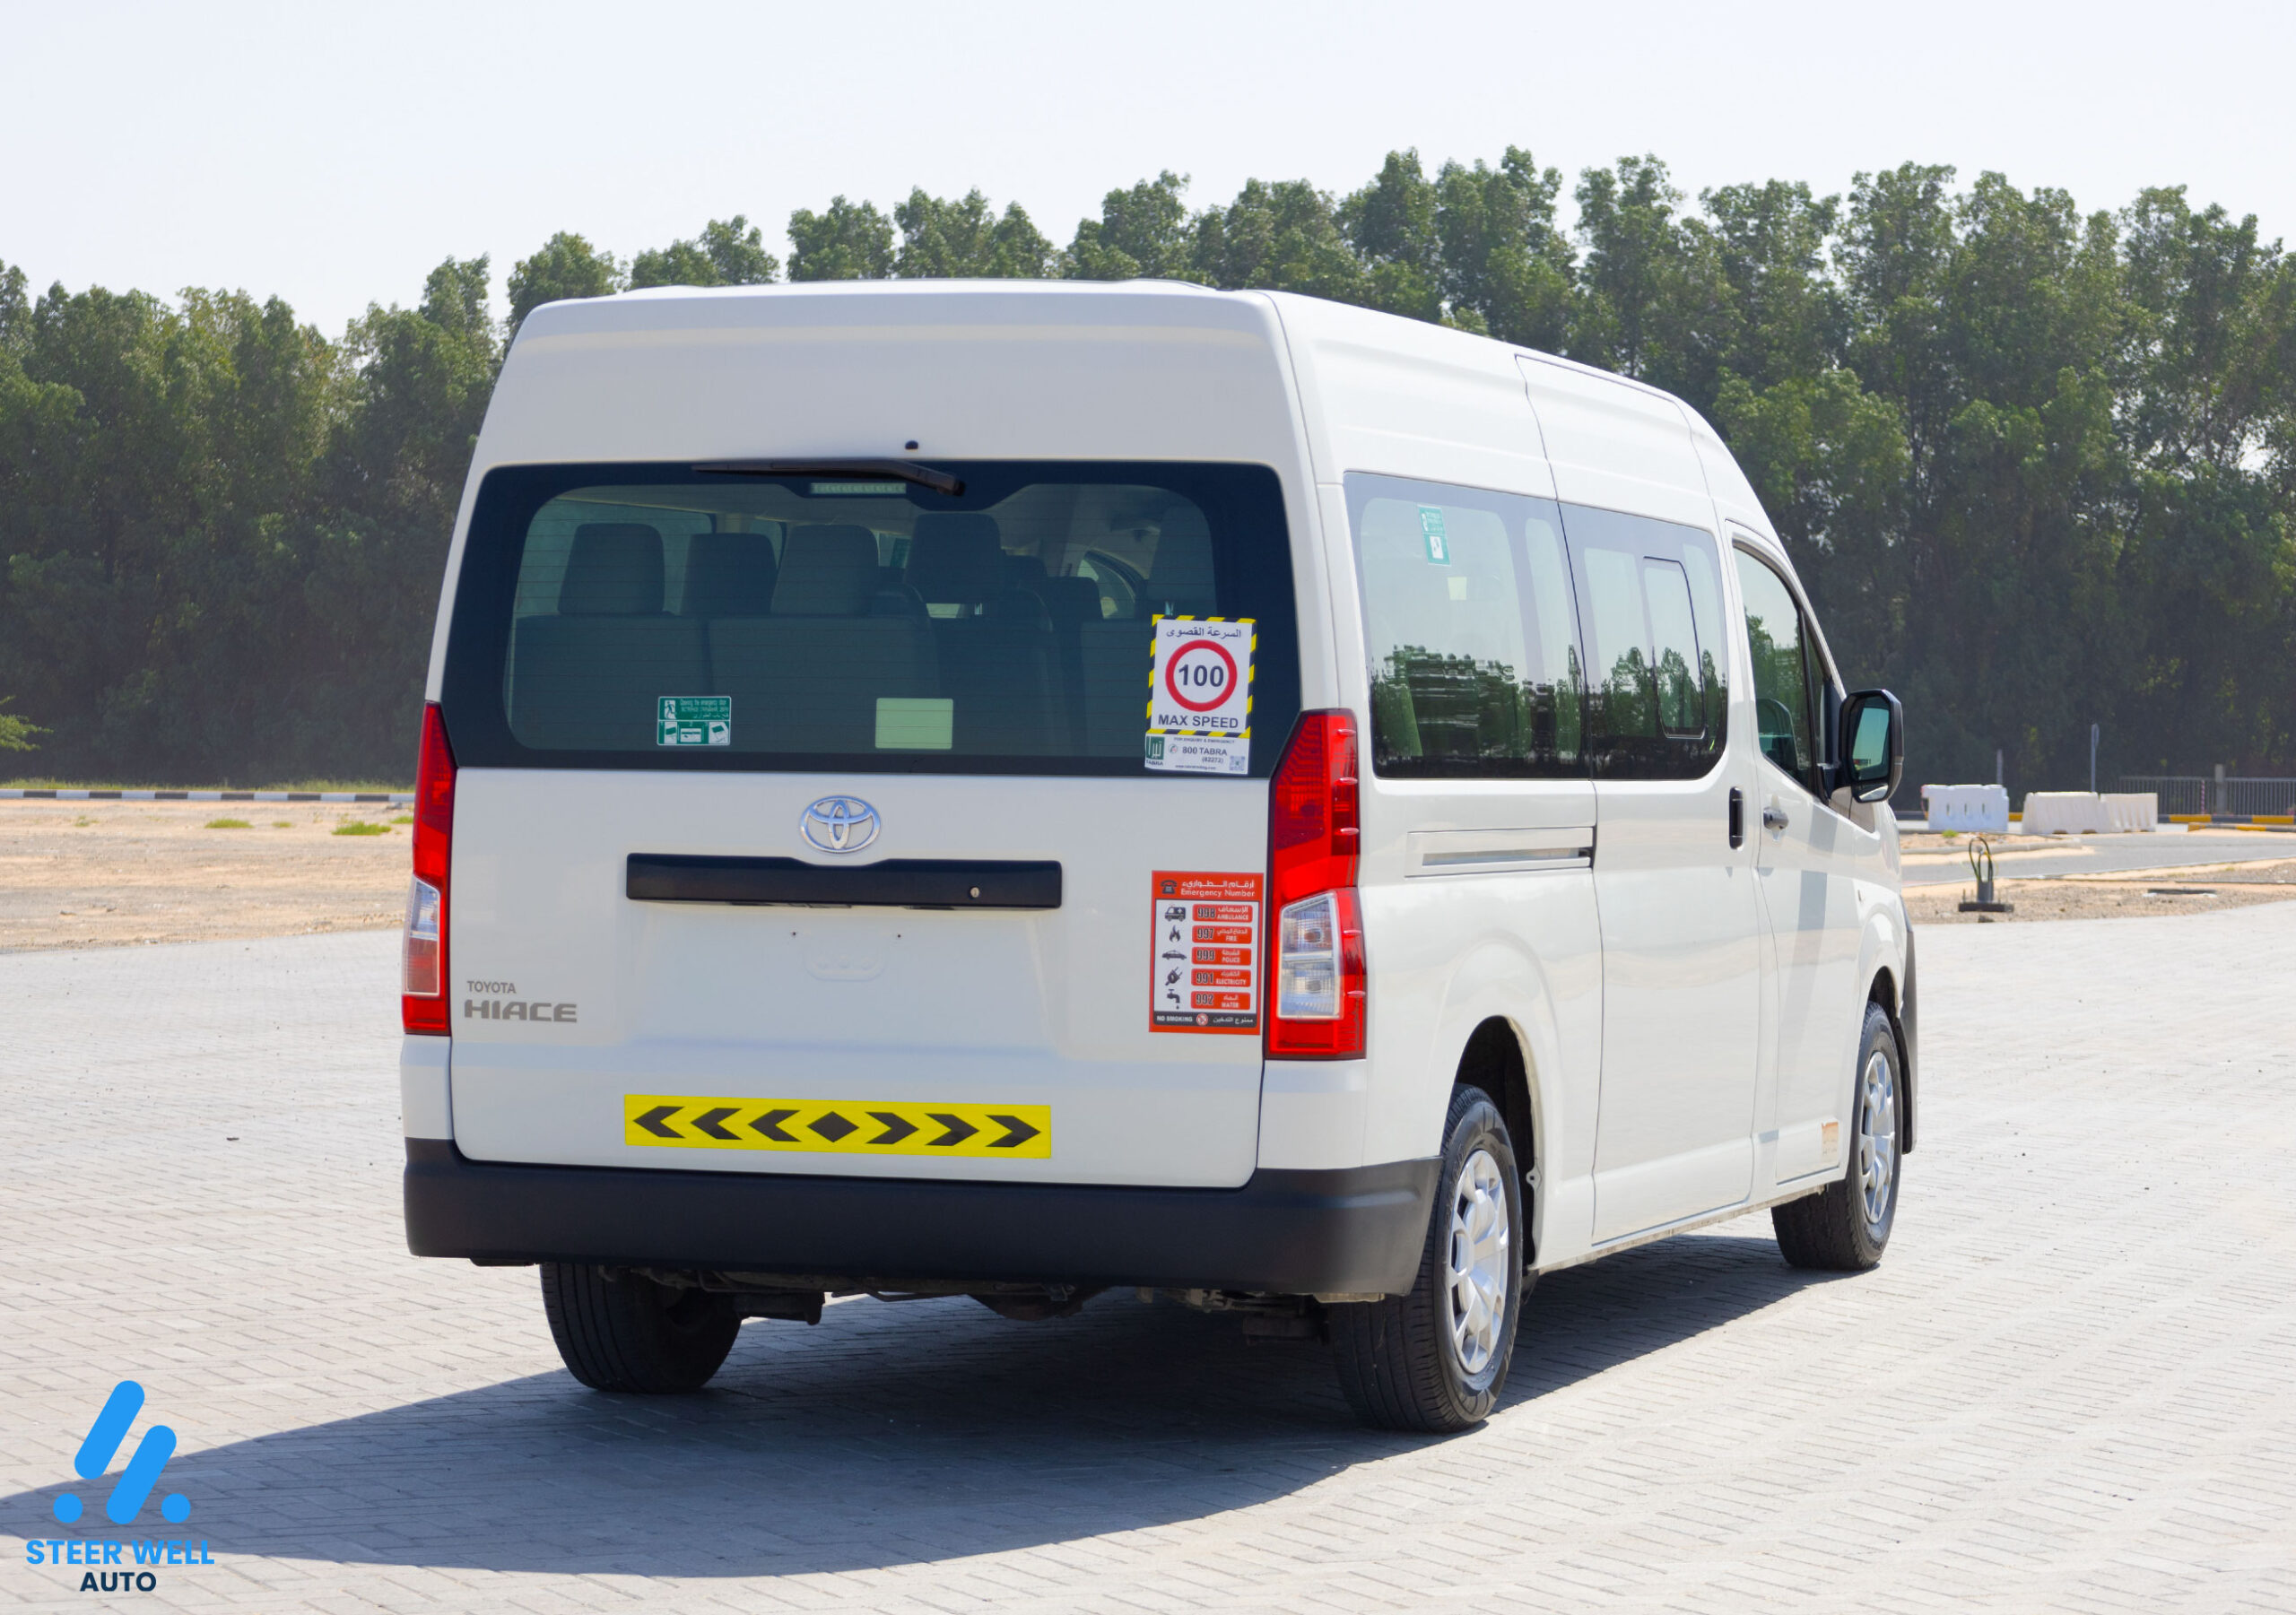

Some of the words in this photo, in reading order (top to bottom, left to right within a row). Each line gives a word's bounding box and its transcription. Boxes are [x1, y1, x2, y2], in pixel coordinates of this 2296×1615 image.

[1167, 627, 1205, 638] القصوى
[1207, 626, 1241, 639] السرعة
[1178, 664, 1224, 687] 100
[1158, 714, 1188, 726] MAX
[1192, 716, 1239, 729] SPEED
[1182, 746, 1197, 754] 800
[1199, 747, 1227, 756] TABRA
[1180, 889, 1222, 897] Emergency
[1197, 907, 1215, 918] 998
[1197, 928, 1213, 939] 997
[1196, 950, 1215, 961] 999
[1196, 972, 1213, 984] 991
[466, 980, 517, 994] TOYOTA
[1196, 994, 1213, 1005] 992
[465, 999, 577, 1023] HIACE
